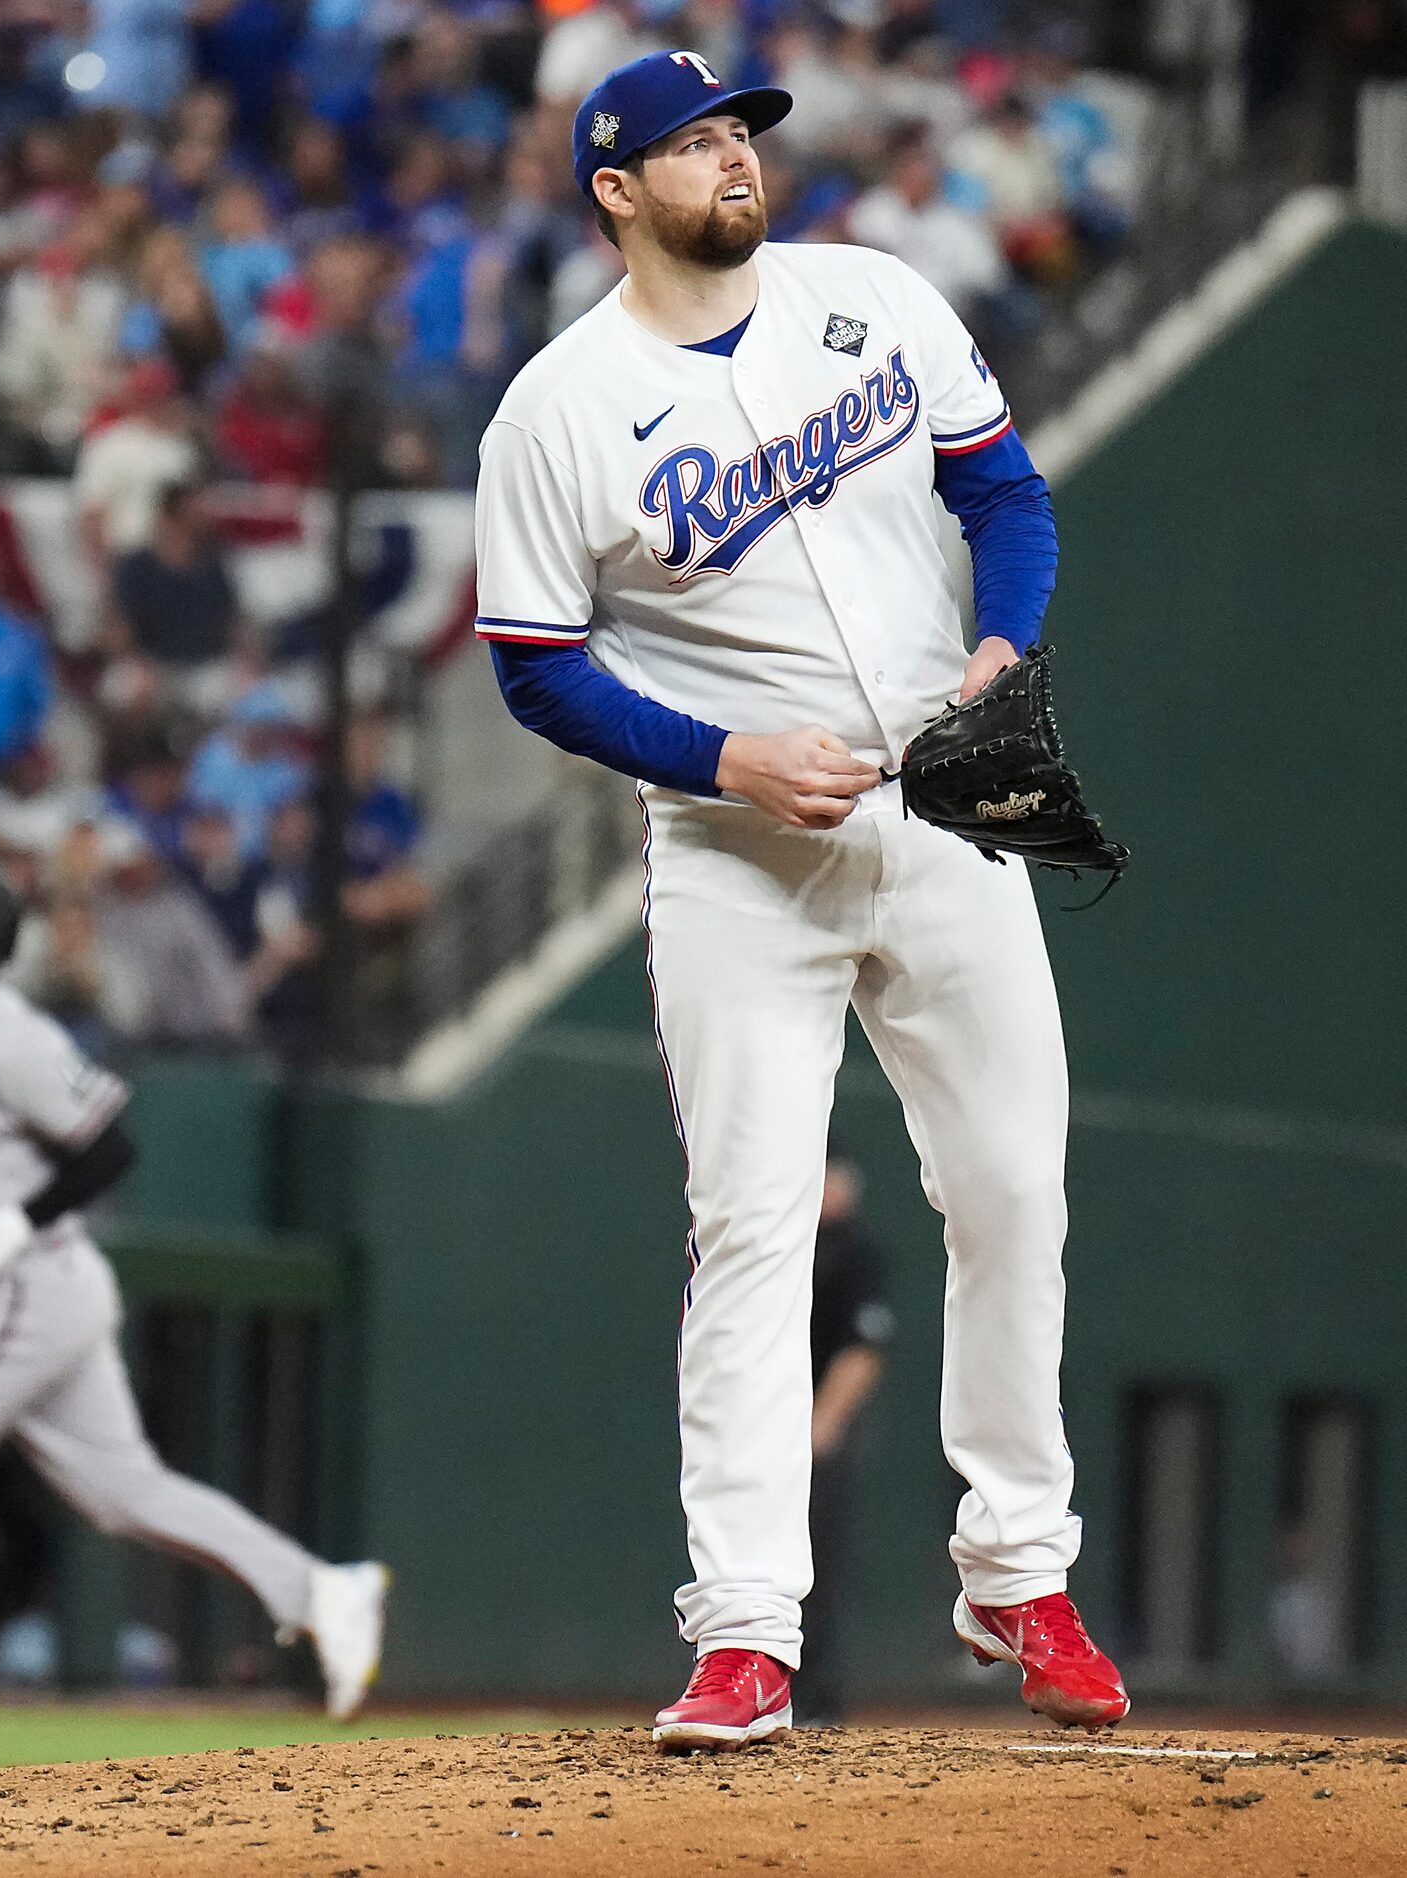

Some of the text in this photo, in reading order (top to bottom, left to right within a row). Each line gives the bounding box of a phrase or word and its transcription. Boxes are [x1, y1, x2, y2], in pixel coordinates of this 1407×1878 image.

[669, 51, 721, 88] T
[824, 321, 862, 342] WORLD
[831, 328, 867, 350] SERIES
[639, 344, 920, 580] Rangers
[976, 789, 1046, 820] Rawlings
